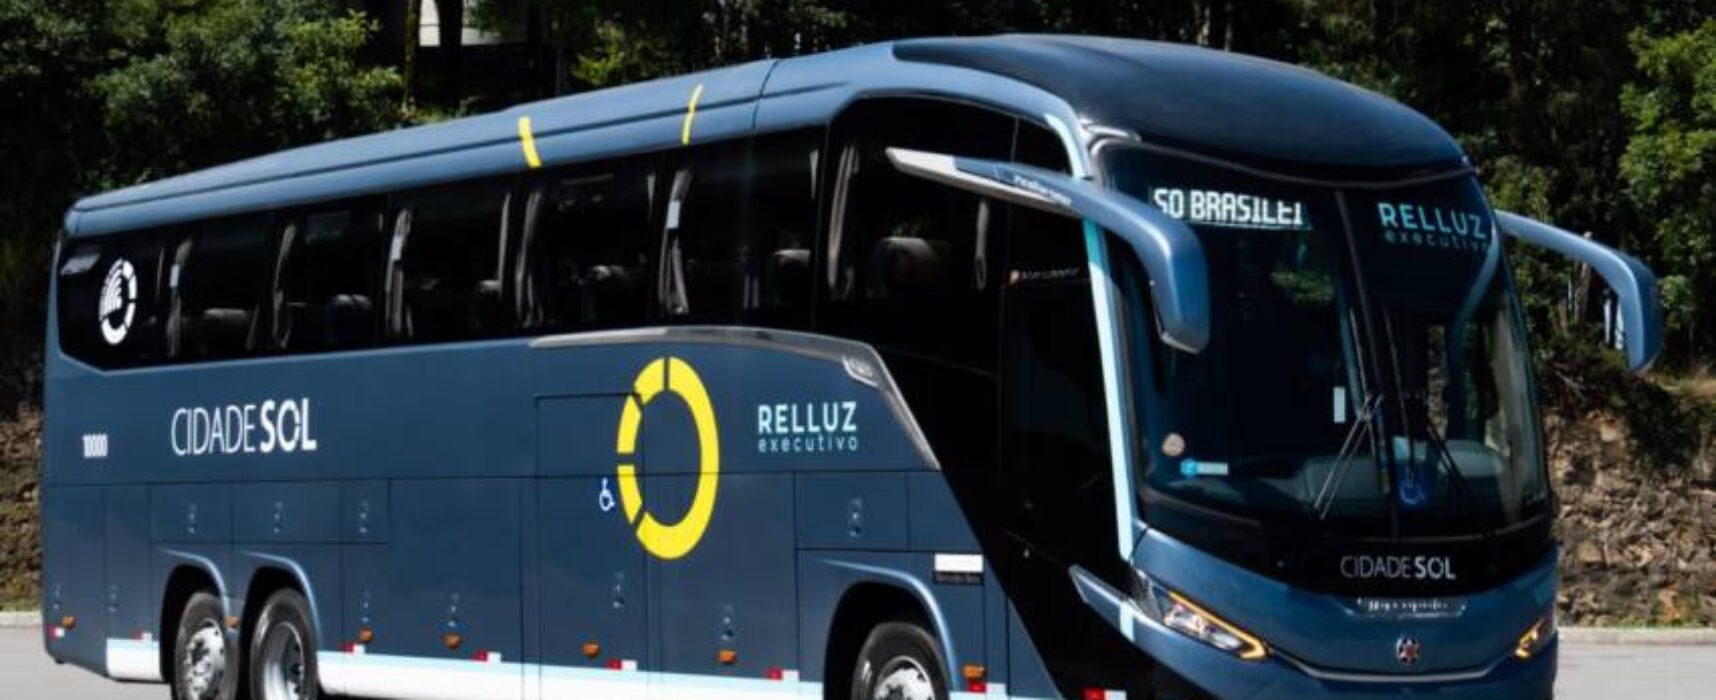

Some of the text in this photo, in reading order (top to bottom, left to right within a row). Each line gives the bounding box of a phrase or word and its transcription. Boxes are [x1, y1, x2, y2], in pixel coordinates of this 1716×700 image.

[1154, 187, 1184, 219] SO
[1377, 202, 1487, 239] RELLUZ
[171, 398, 317, 455] CIDADE SOL
[758, 401, 857, 433] RELLUZ
[758, 434, 858, 452] executivo
[1340, 555, 1456, 579] CIDADE SOL
